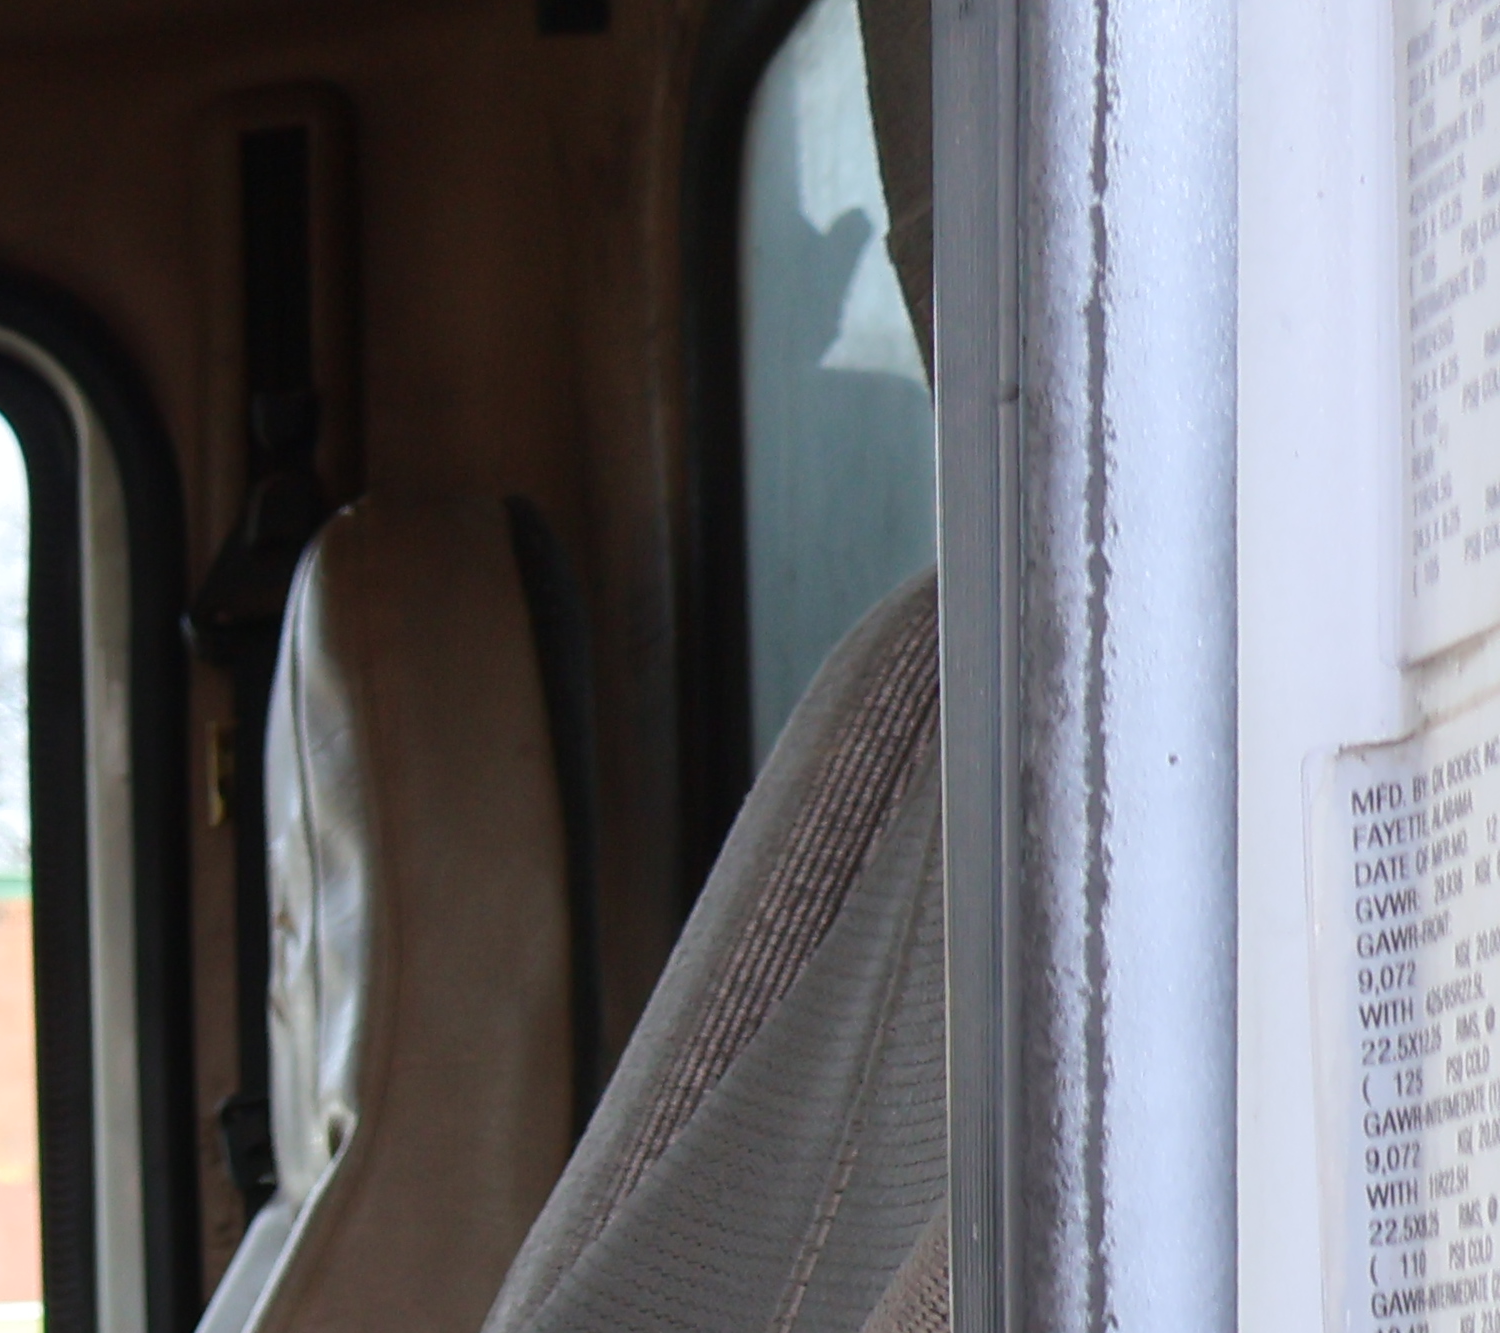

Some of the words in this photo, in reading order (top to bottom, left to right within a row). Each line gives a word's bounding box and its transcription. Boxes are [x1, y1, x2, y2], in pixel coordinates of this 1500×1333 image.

[1352, 783, 1406, 814] MFD.
[1413, 776, 1426, 802] BY
[1355, 853, 1409, 886] DATE
[1359, 998, 1413, 1029] WITH
[1363, 1075, 1371, 1106] (
[1394, 1066, 1423, 1096] 125
[1466, 1045, 1489, 1078] COLD
[1367, 1179, 1418, 1209] WITH
[1370, 1255, 1378, 1286] (
[1401, 1249, 1426, 1278] 110
[1468, 1235, 1492, 1266] COLD
